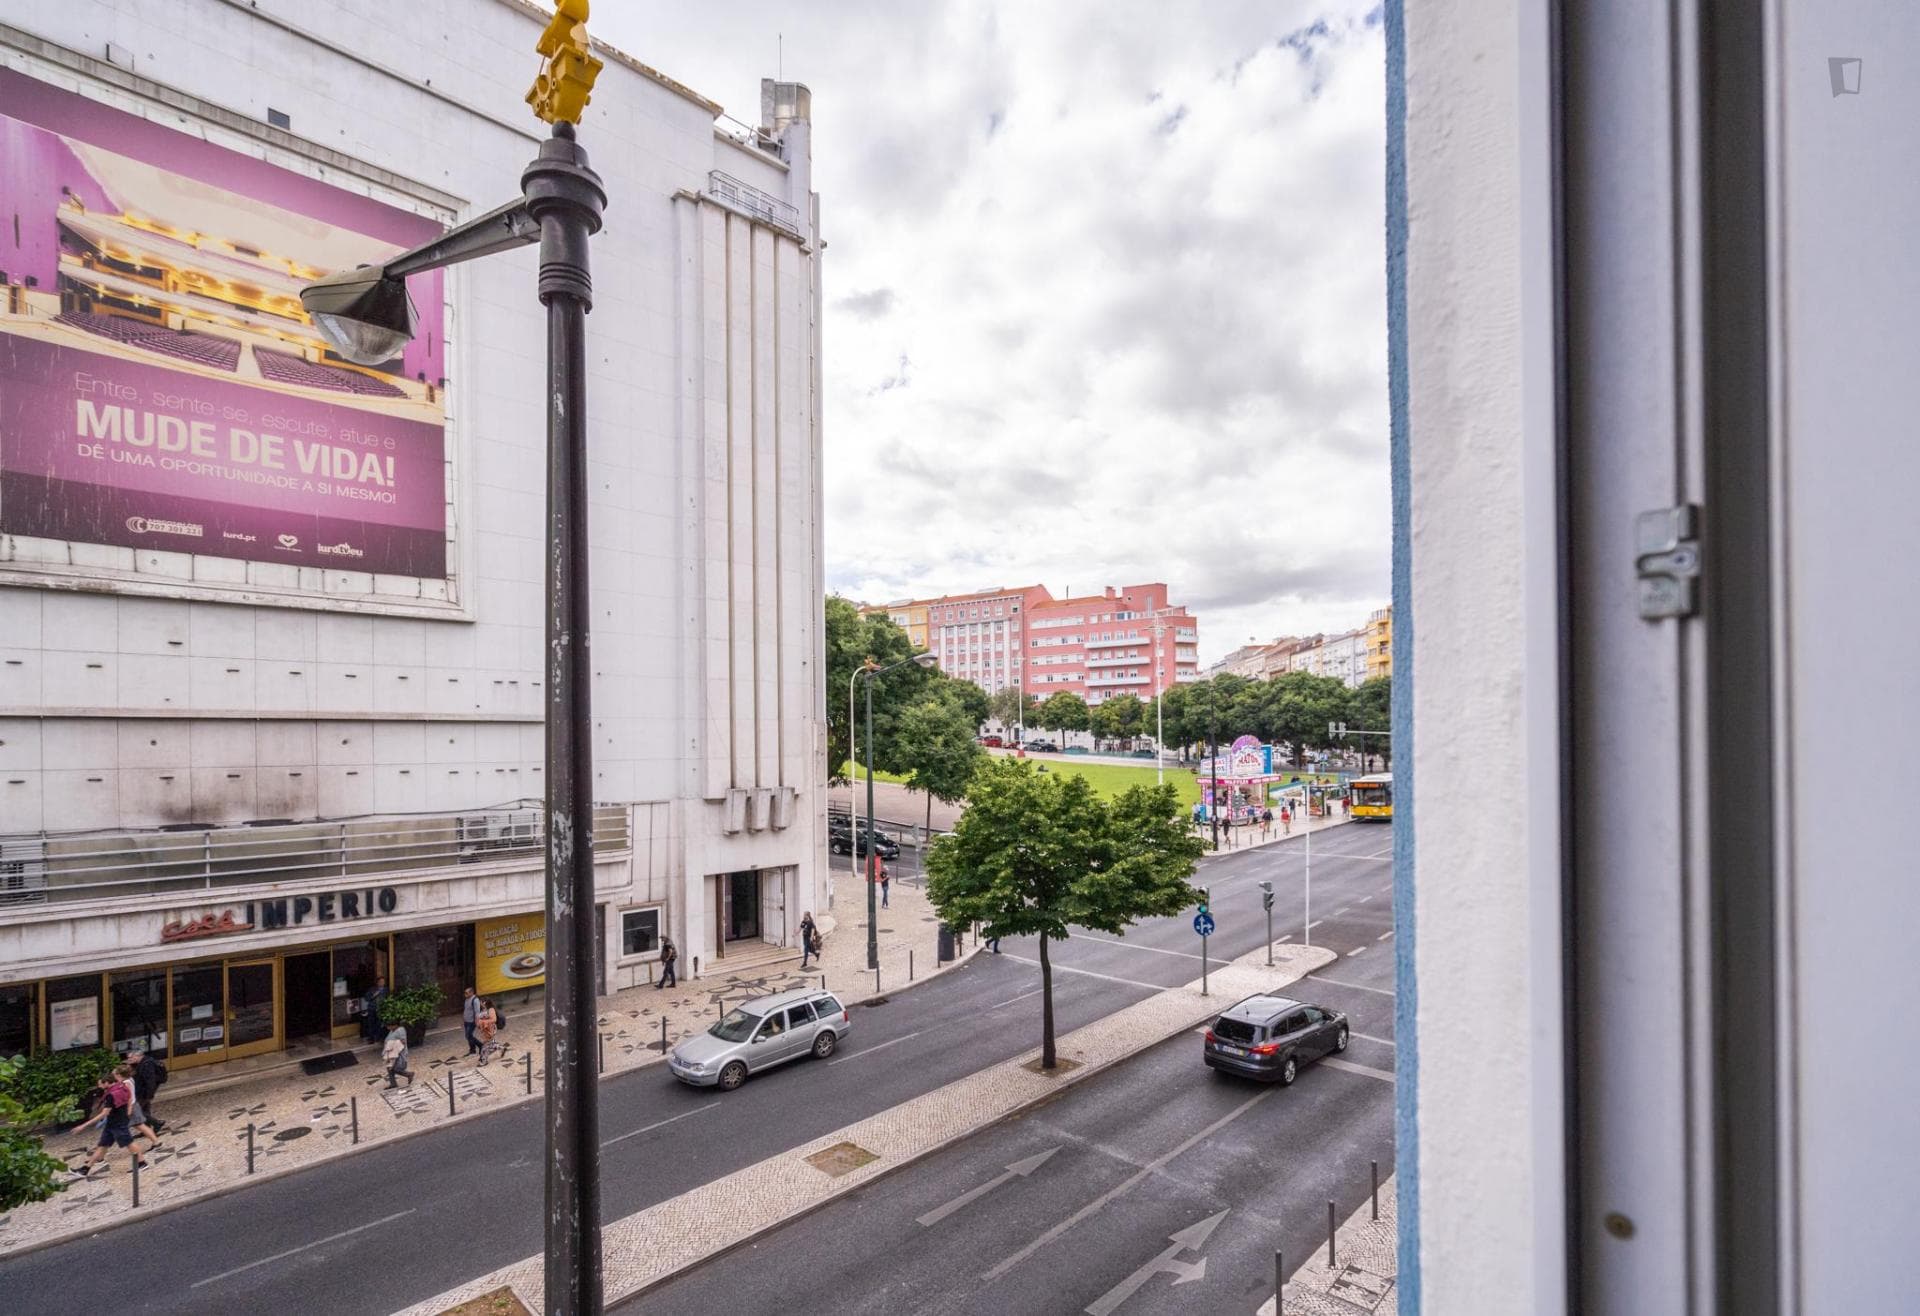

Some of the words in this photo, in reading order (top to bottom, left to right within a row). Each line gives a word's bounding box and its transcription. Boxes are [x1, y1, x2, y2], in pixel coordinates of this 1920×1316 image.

[75, 371, 142, 404] Entre,
[340, 427, 379, 447] atue
[76, 399, 217, 459] MUDE
[230, 428, 286, 470] DE
[293, 439, 395, 488] VIDA!
[78, 443, 104, 460] DÊ
[111, 449, 156, 468] UMA
[160, 457, 298, 490] OPORTUNIDADE
[302, 480, 314, 493] A
[318, 482, 332, 495] SI
[336, 485, 397, 505] MESMO!
